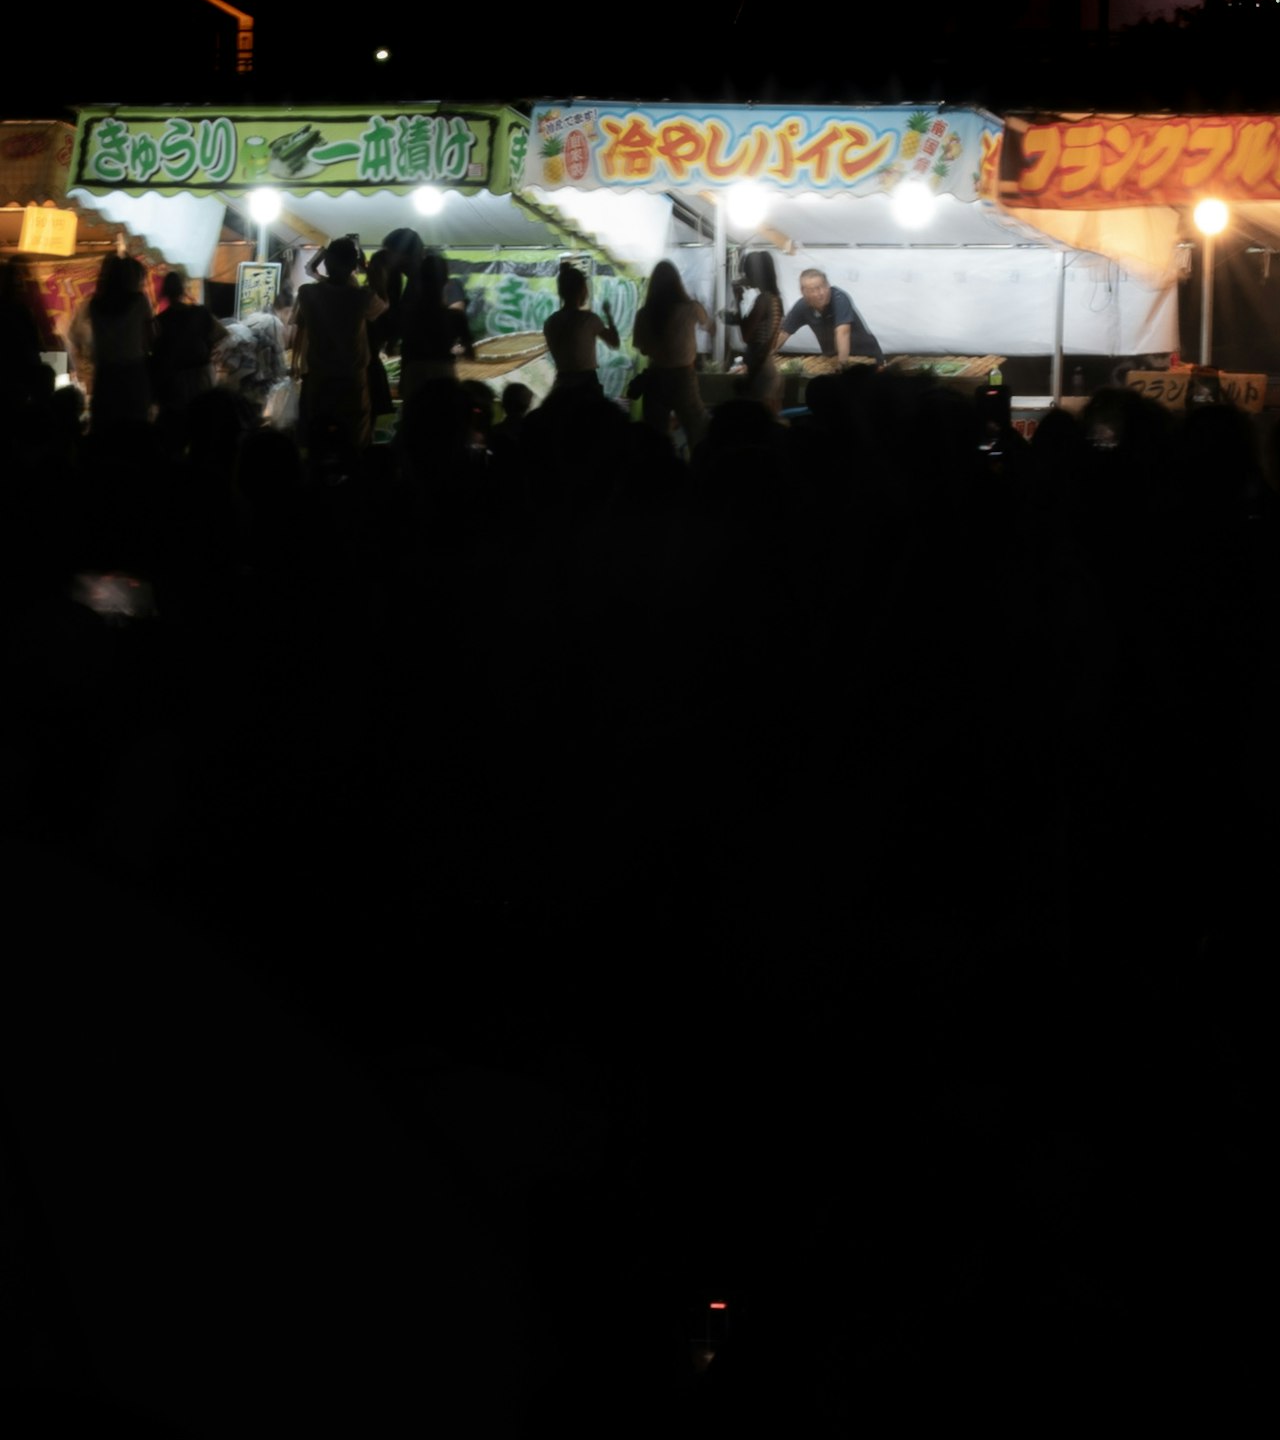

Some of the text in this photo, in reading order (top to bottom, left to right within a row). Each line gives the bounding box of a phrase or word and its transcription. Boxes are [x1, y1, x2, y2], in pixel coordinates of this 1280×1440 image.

[93, 117, 236, 182] きゅうり
[307, 115, 474, 182] 一本漬け
[600, 114, 892, 181] 冷やしパイン
